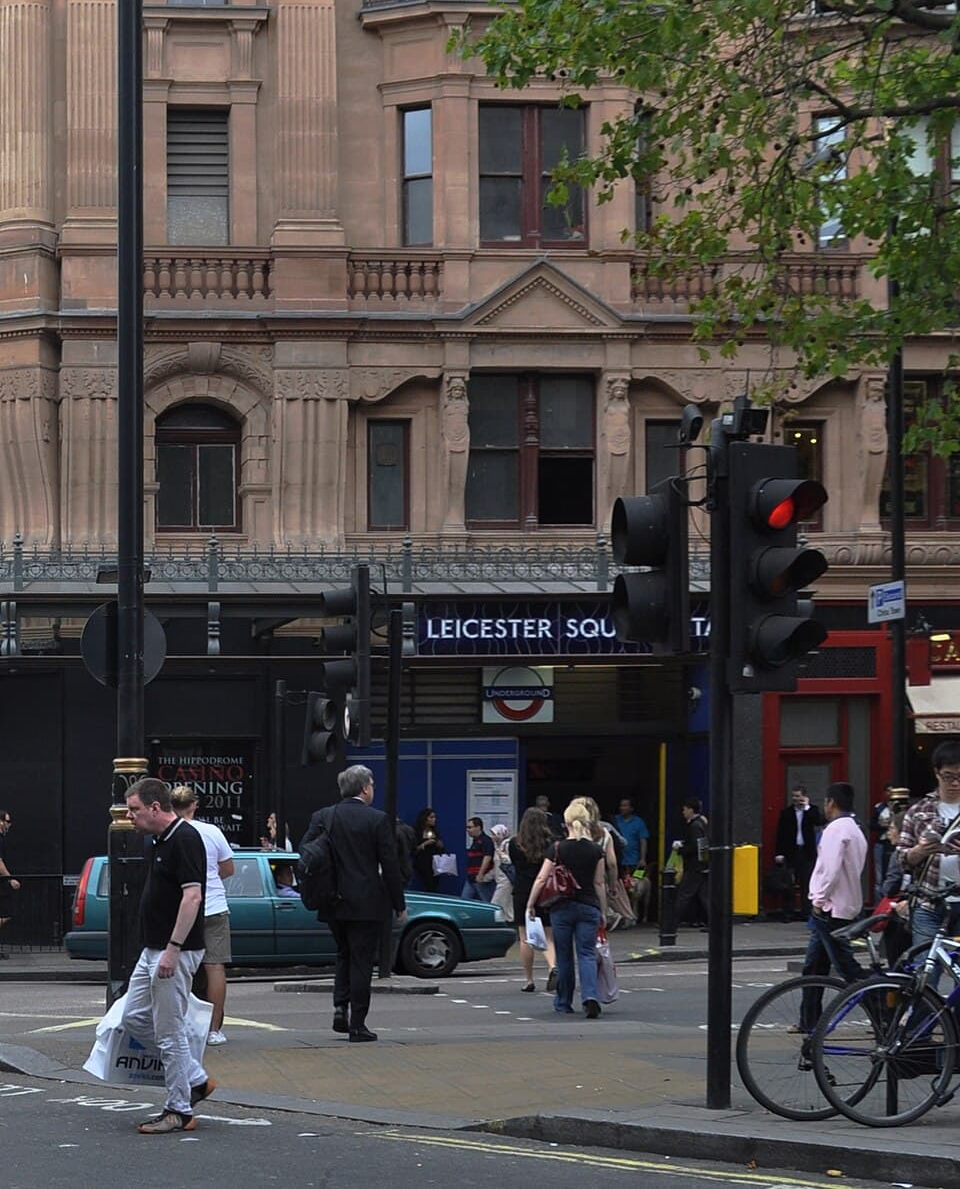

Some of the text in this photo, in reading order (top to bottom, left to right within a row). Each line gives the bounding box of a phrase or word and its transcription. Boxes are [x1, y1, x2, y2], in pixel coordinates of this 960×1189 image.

[427, 618, 617, 639] LEICESTER SQU
[486, 688, 550, 698] UNDERGROUND
[159, 757, 243, 765] THE HIPPODROME
[159, 766, 244, 780] CASINO
[205, 795, 242, 809] 2011
[214, 816, 224, 824] BE
